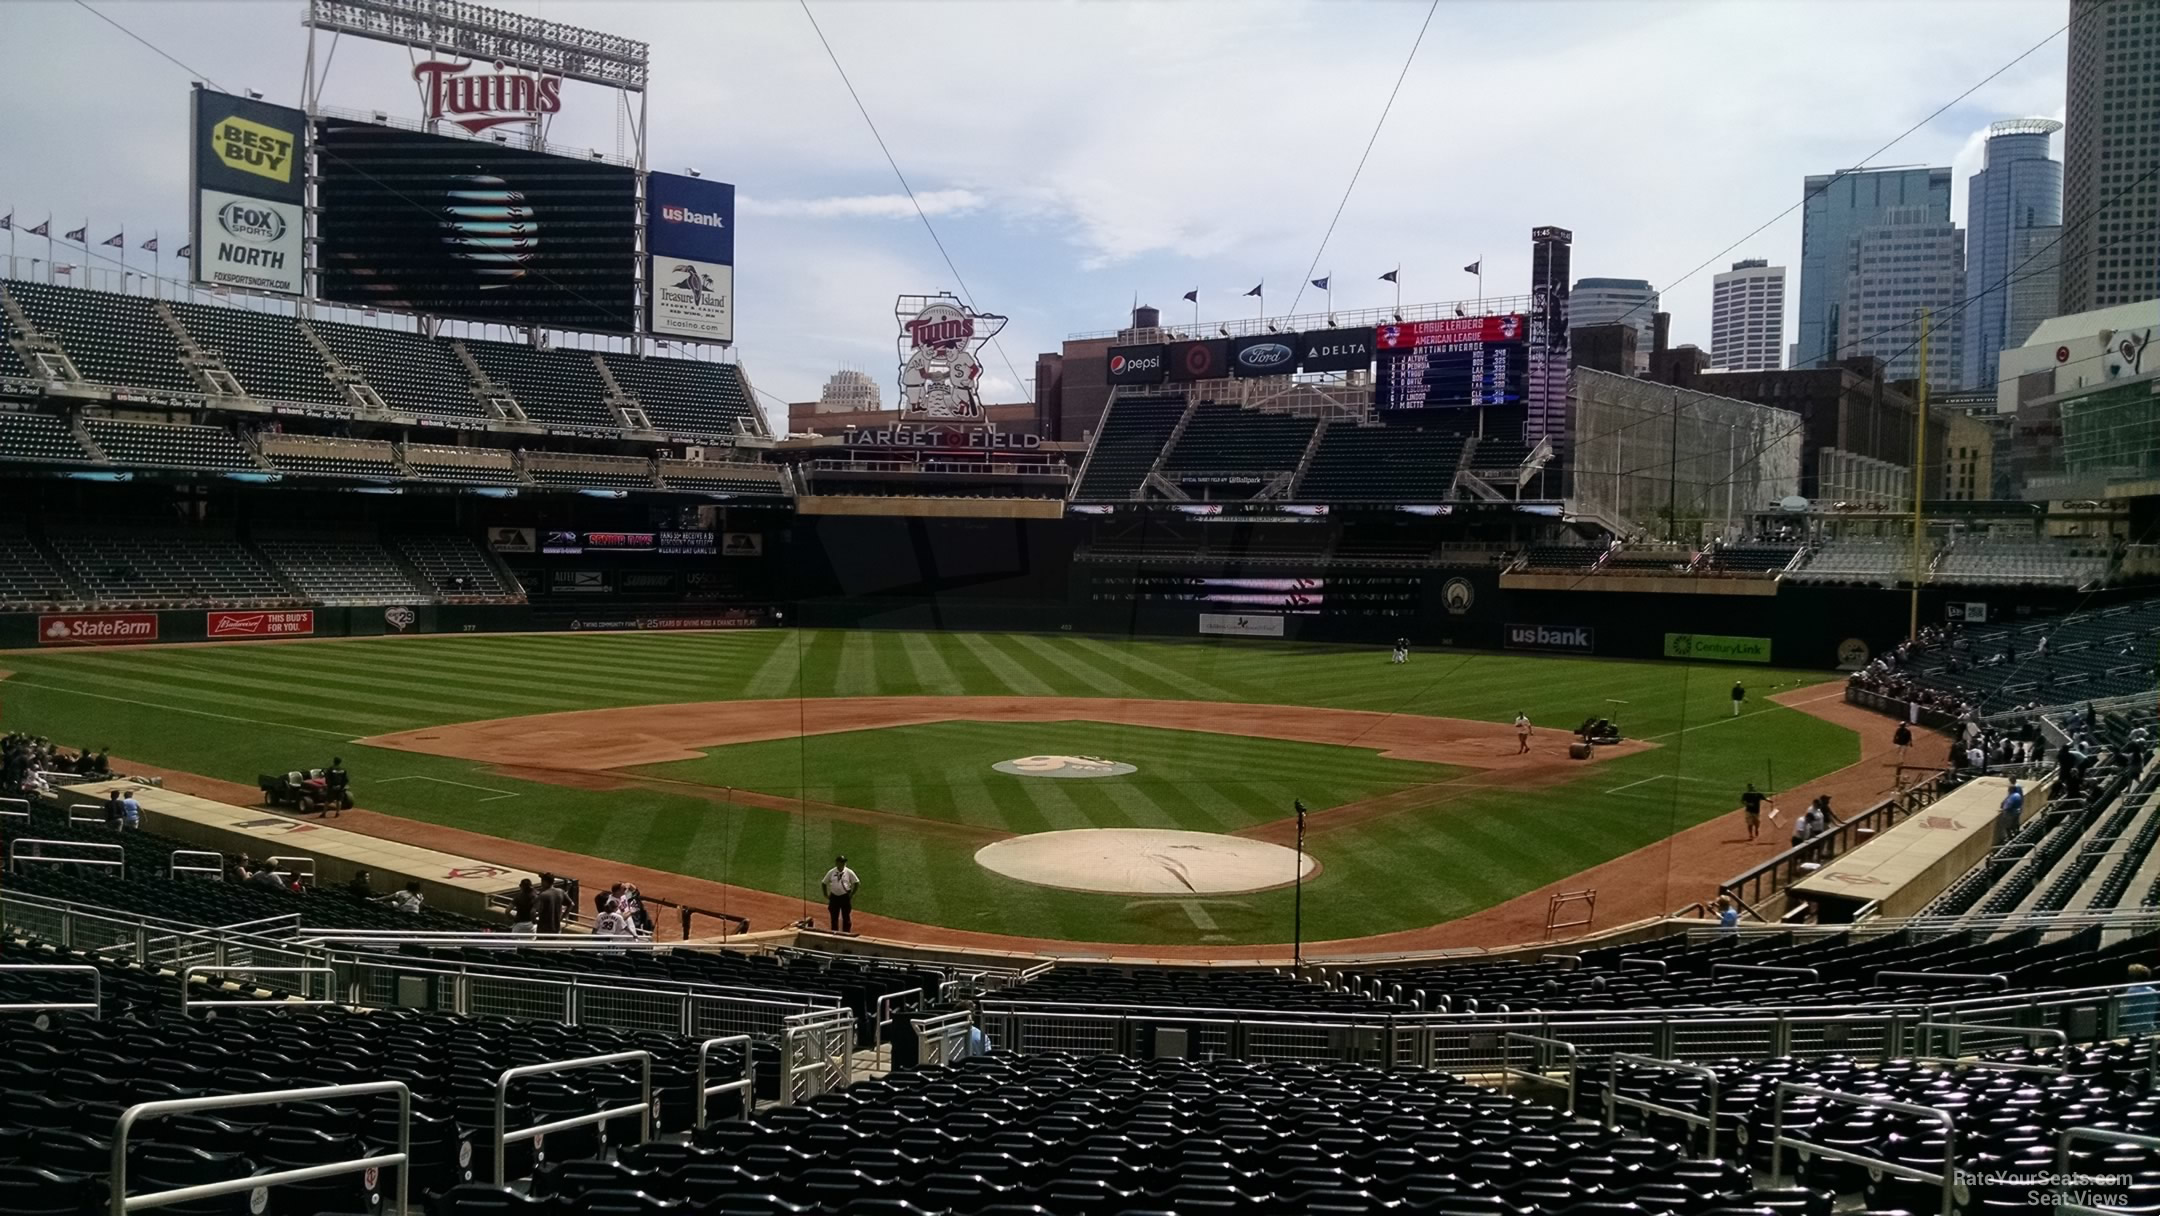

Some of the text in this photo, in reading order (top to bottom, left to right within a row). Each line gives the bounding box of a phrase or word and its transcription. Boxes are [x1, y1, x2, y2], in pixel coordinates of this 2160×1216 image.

[412, 59, 561, 122] Twins
[224, 124, 290, 157] BEST
[225, 142, 285, 171] BUY
[233, 207, 272, 229] FOX
[232, 224, 273, 238] SPORTS
[1533, 229, 1550, 237] 11:45
[218, 242, 285, 269] NORTH
[213, 271, 291, 290] FOXSPORTSNORTH.COM
[660, 288, 726, 308] Treasure Island
[666, 319, 719, 332] ticasino.com
[1413, 319, 1483, 334] LEAGUE LEADERS
[904, 315, 975, 351] Twins
[1415, 332, 1481, 346] AMERICAN LEAGUE
[1249, 346, 1280, 363] Ford
[1322, 343, 1366, 356] DELTA
[1413, 344, 1446, 354] BATTING
[1127, 356, 1160, 372] pepsi
[844, 431, 1041, 449] TARGET FIELD
[589, 534, 626, 545] SENIOR
[627, 534, 653, 546] DAYS
[624, 574, 674, 587] SUBWAY
[220, 618, 259, 630] Budweiser
[267, 614, 307, 623] THIS BUD'S
[399, 612, 414, 623] 29
[647, 619, 658, 628] 25
[717, 619, 736, 627] CHANCE
[267, 622, 300, 632] FOR YOU.
[1695, 641, 1761, 657] CenturyLink
